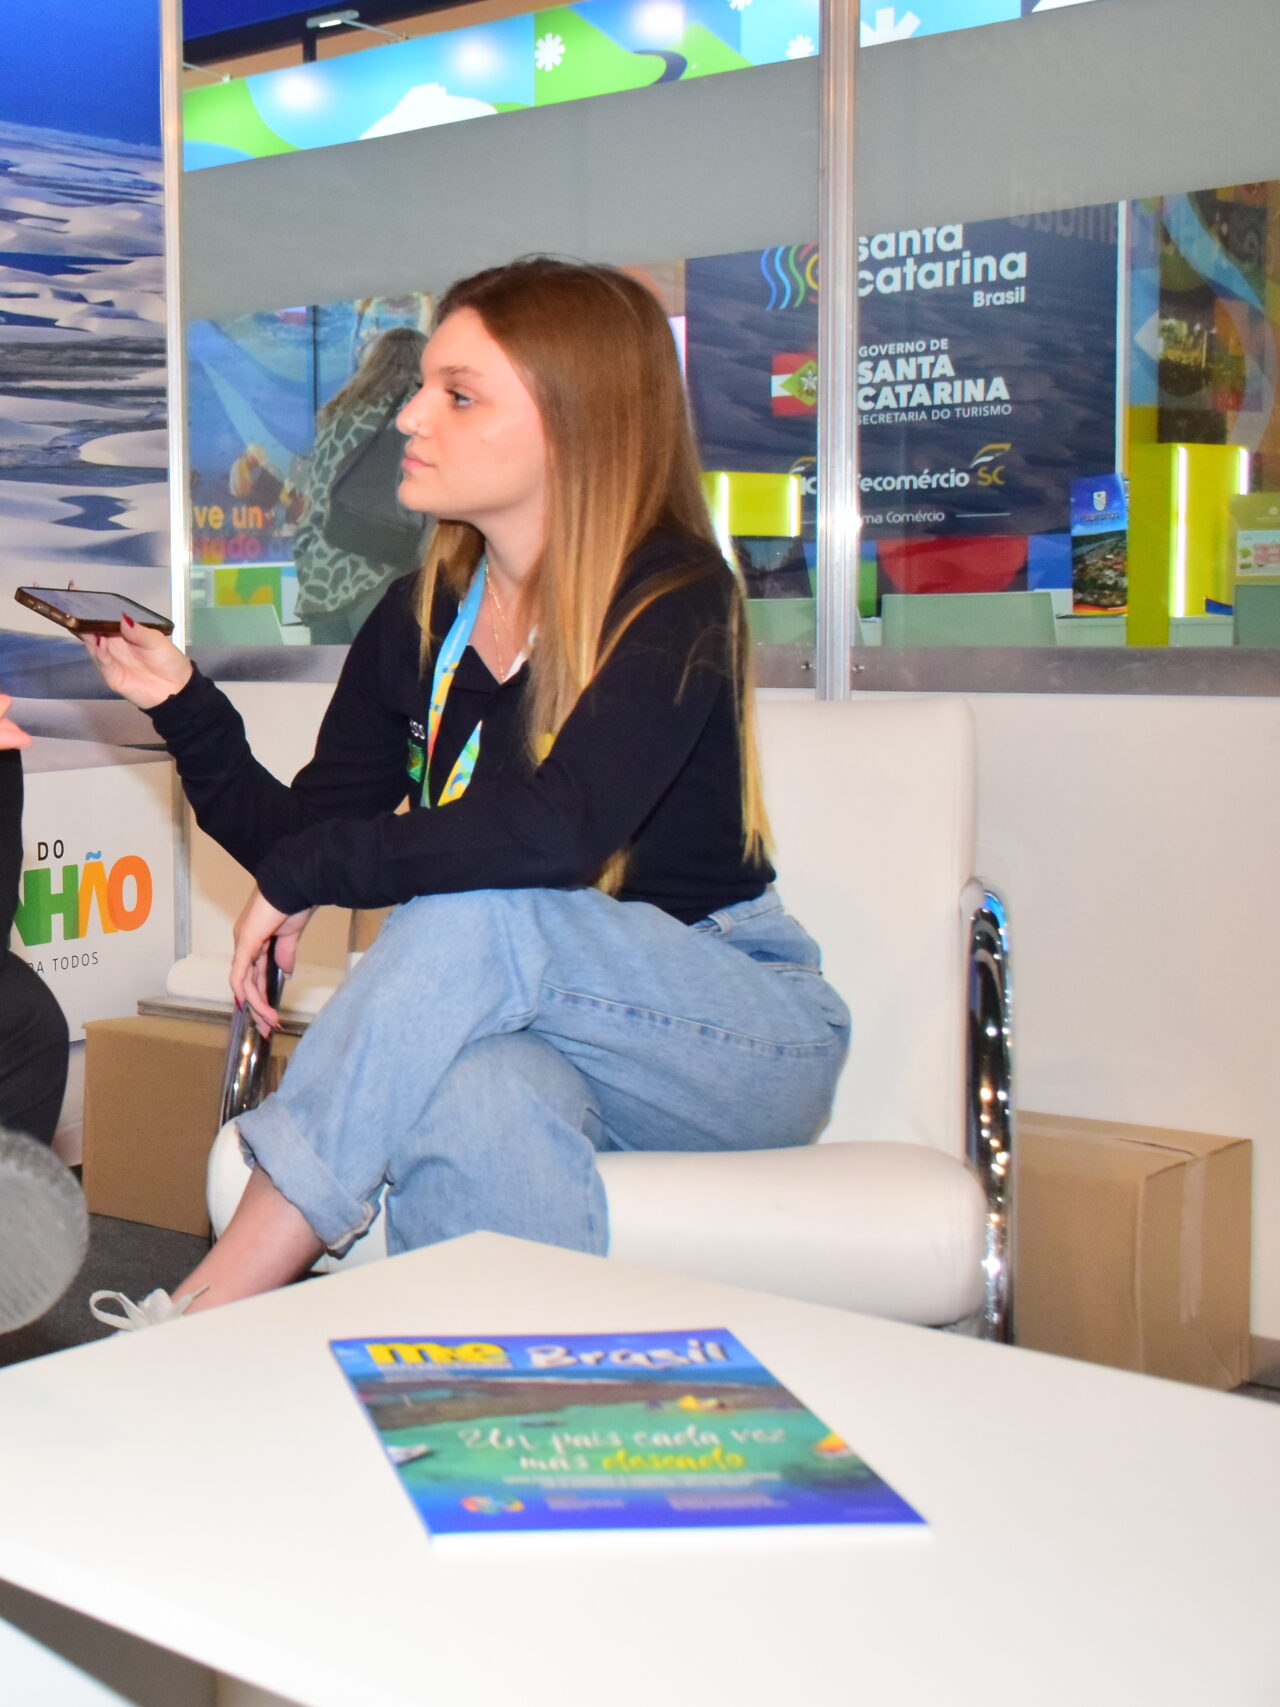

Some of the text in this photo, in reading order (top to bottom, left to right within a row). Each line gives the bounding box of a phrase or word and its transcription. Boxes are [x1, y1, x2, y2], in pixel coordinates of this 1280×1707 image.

[858, 251, 1027, 297] catarina
[973, 286, 1025, 307] Brasil
[858, 338, 949, 358] GOVERNO DE
[857, 354, 955, 384] SANTA
[857, 376, 1010, 411] CATARINA
[858, 404, 1012, 426] SECRETARIA DO TURISMO
[858, 468, 970, 492] ecomércio
[232, 506, 263, 529] un
[886, 511, 945, 524] Comércio
[37, 839, 65, 861] DO
[52, 951, 99, 972] TODOS
[365, 1338, 729, 1370] me Brasil
